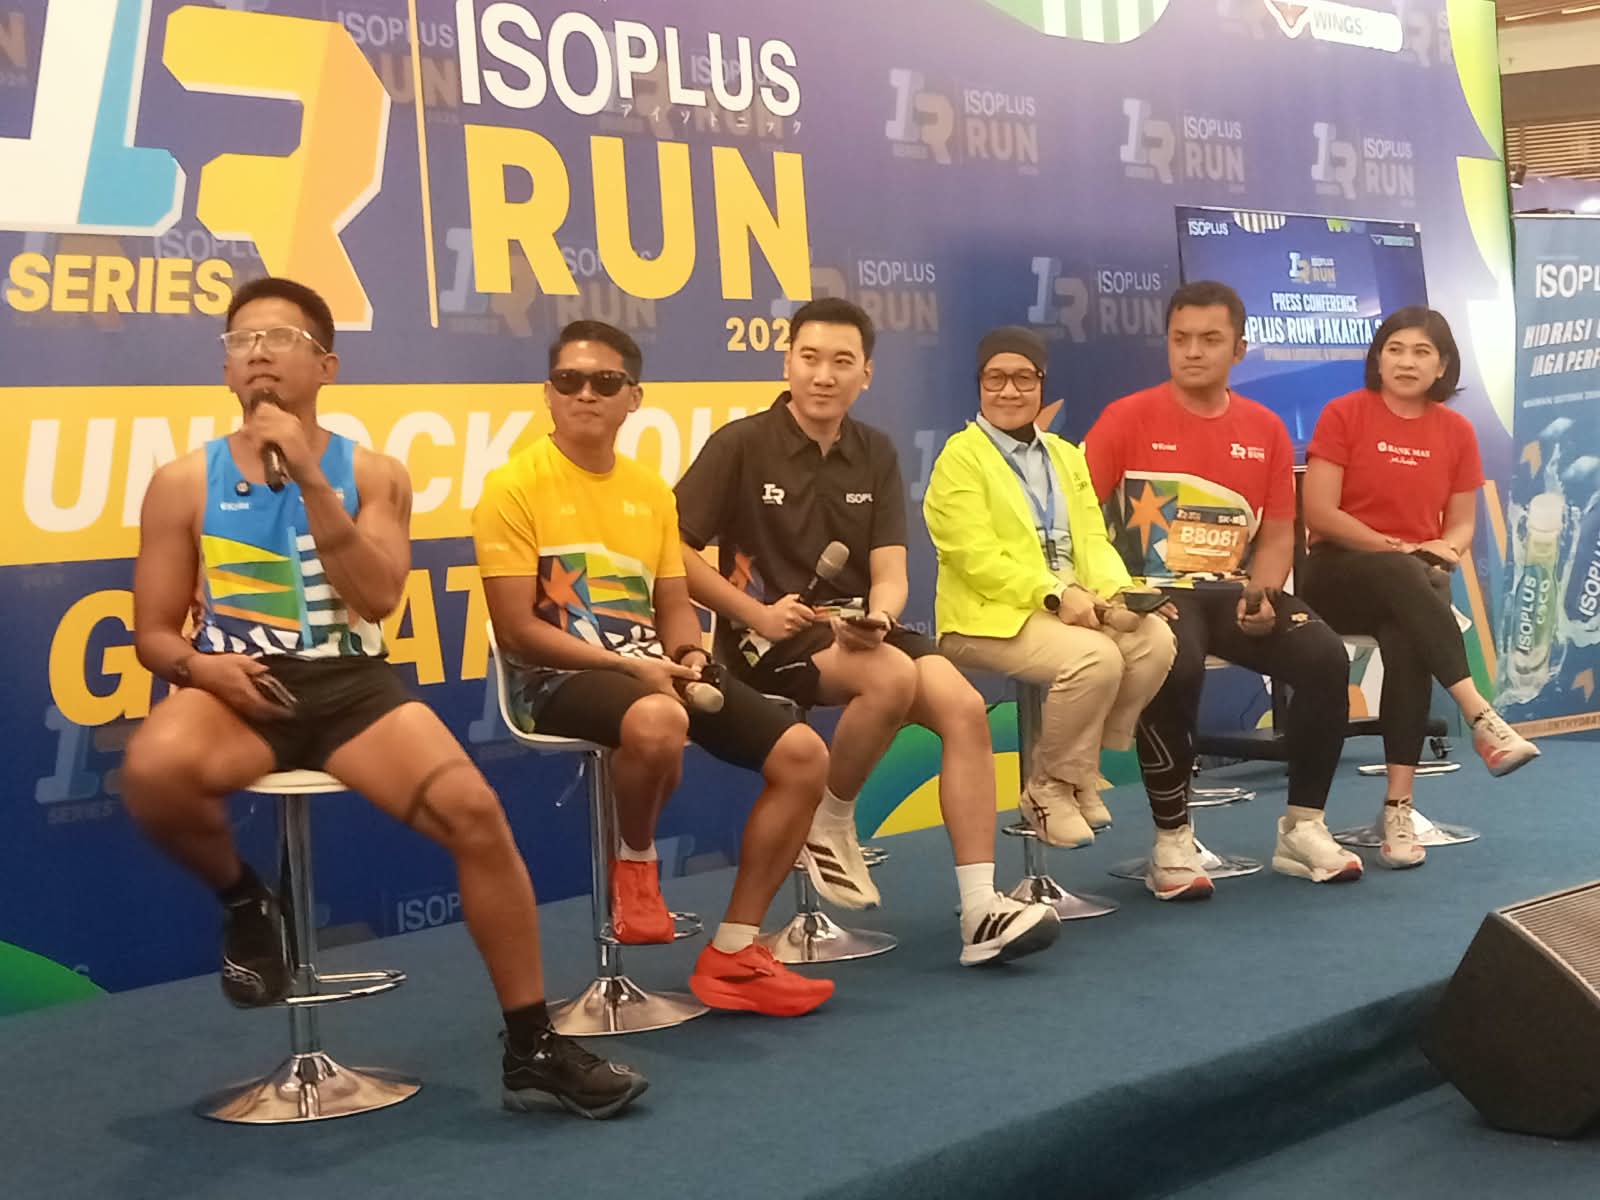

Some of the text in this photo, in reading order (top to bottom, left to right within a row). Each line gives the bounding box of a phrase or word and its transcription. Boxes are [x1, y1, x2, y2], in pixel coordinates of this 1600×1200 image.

[1313, 13, 1364, 36] WINGS
[455, 0, 801, 117] ISOPLUS
[963, 88, 1037, 118] ISOPLUS
[965, 119, 1040, 164] RUN
[1184, 116, 1242, 140] ISOPLUS
[1186, 142, 1245, 182] RUN
[1363, 137, 1413, 159] ISOPLUS
[1365, 161, 1415, 197] RUN
[464, 124, 813, 303] RUN
[1188, 221, 1229, 236] ISOPLUS
[6, 251, 235, 315] SERIES
[857, 259, 937, 286] ISOPLUS
[1097, 270, 1161, 294] ISOPLUS
[1311, 267, 1336, 282] RUN
[1100, 297, 1166, 336] RUN
[1272, 292, 1358, 312] PRESS CONFERENCE
[1286, 316, 1315, 344] RUN
[1319, 318, 1373, 345] JAKARTA
[1523, 318, 1592, 348] HIDRASI
[1530, 352, 1564, 377] JAGA
[1517, 575, 1537, 653] ISOPLUS
